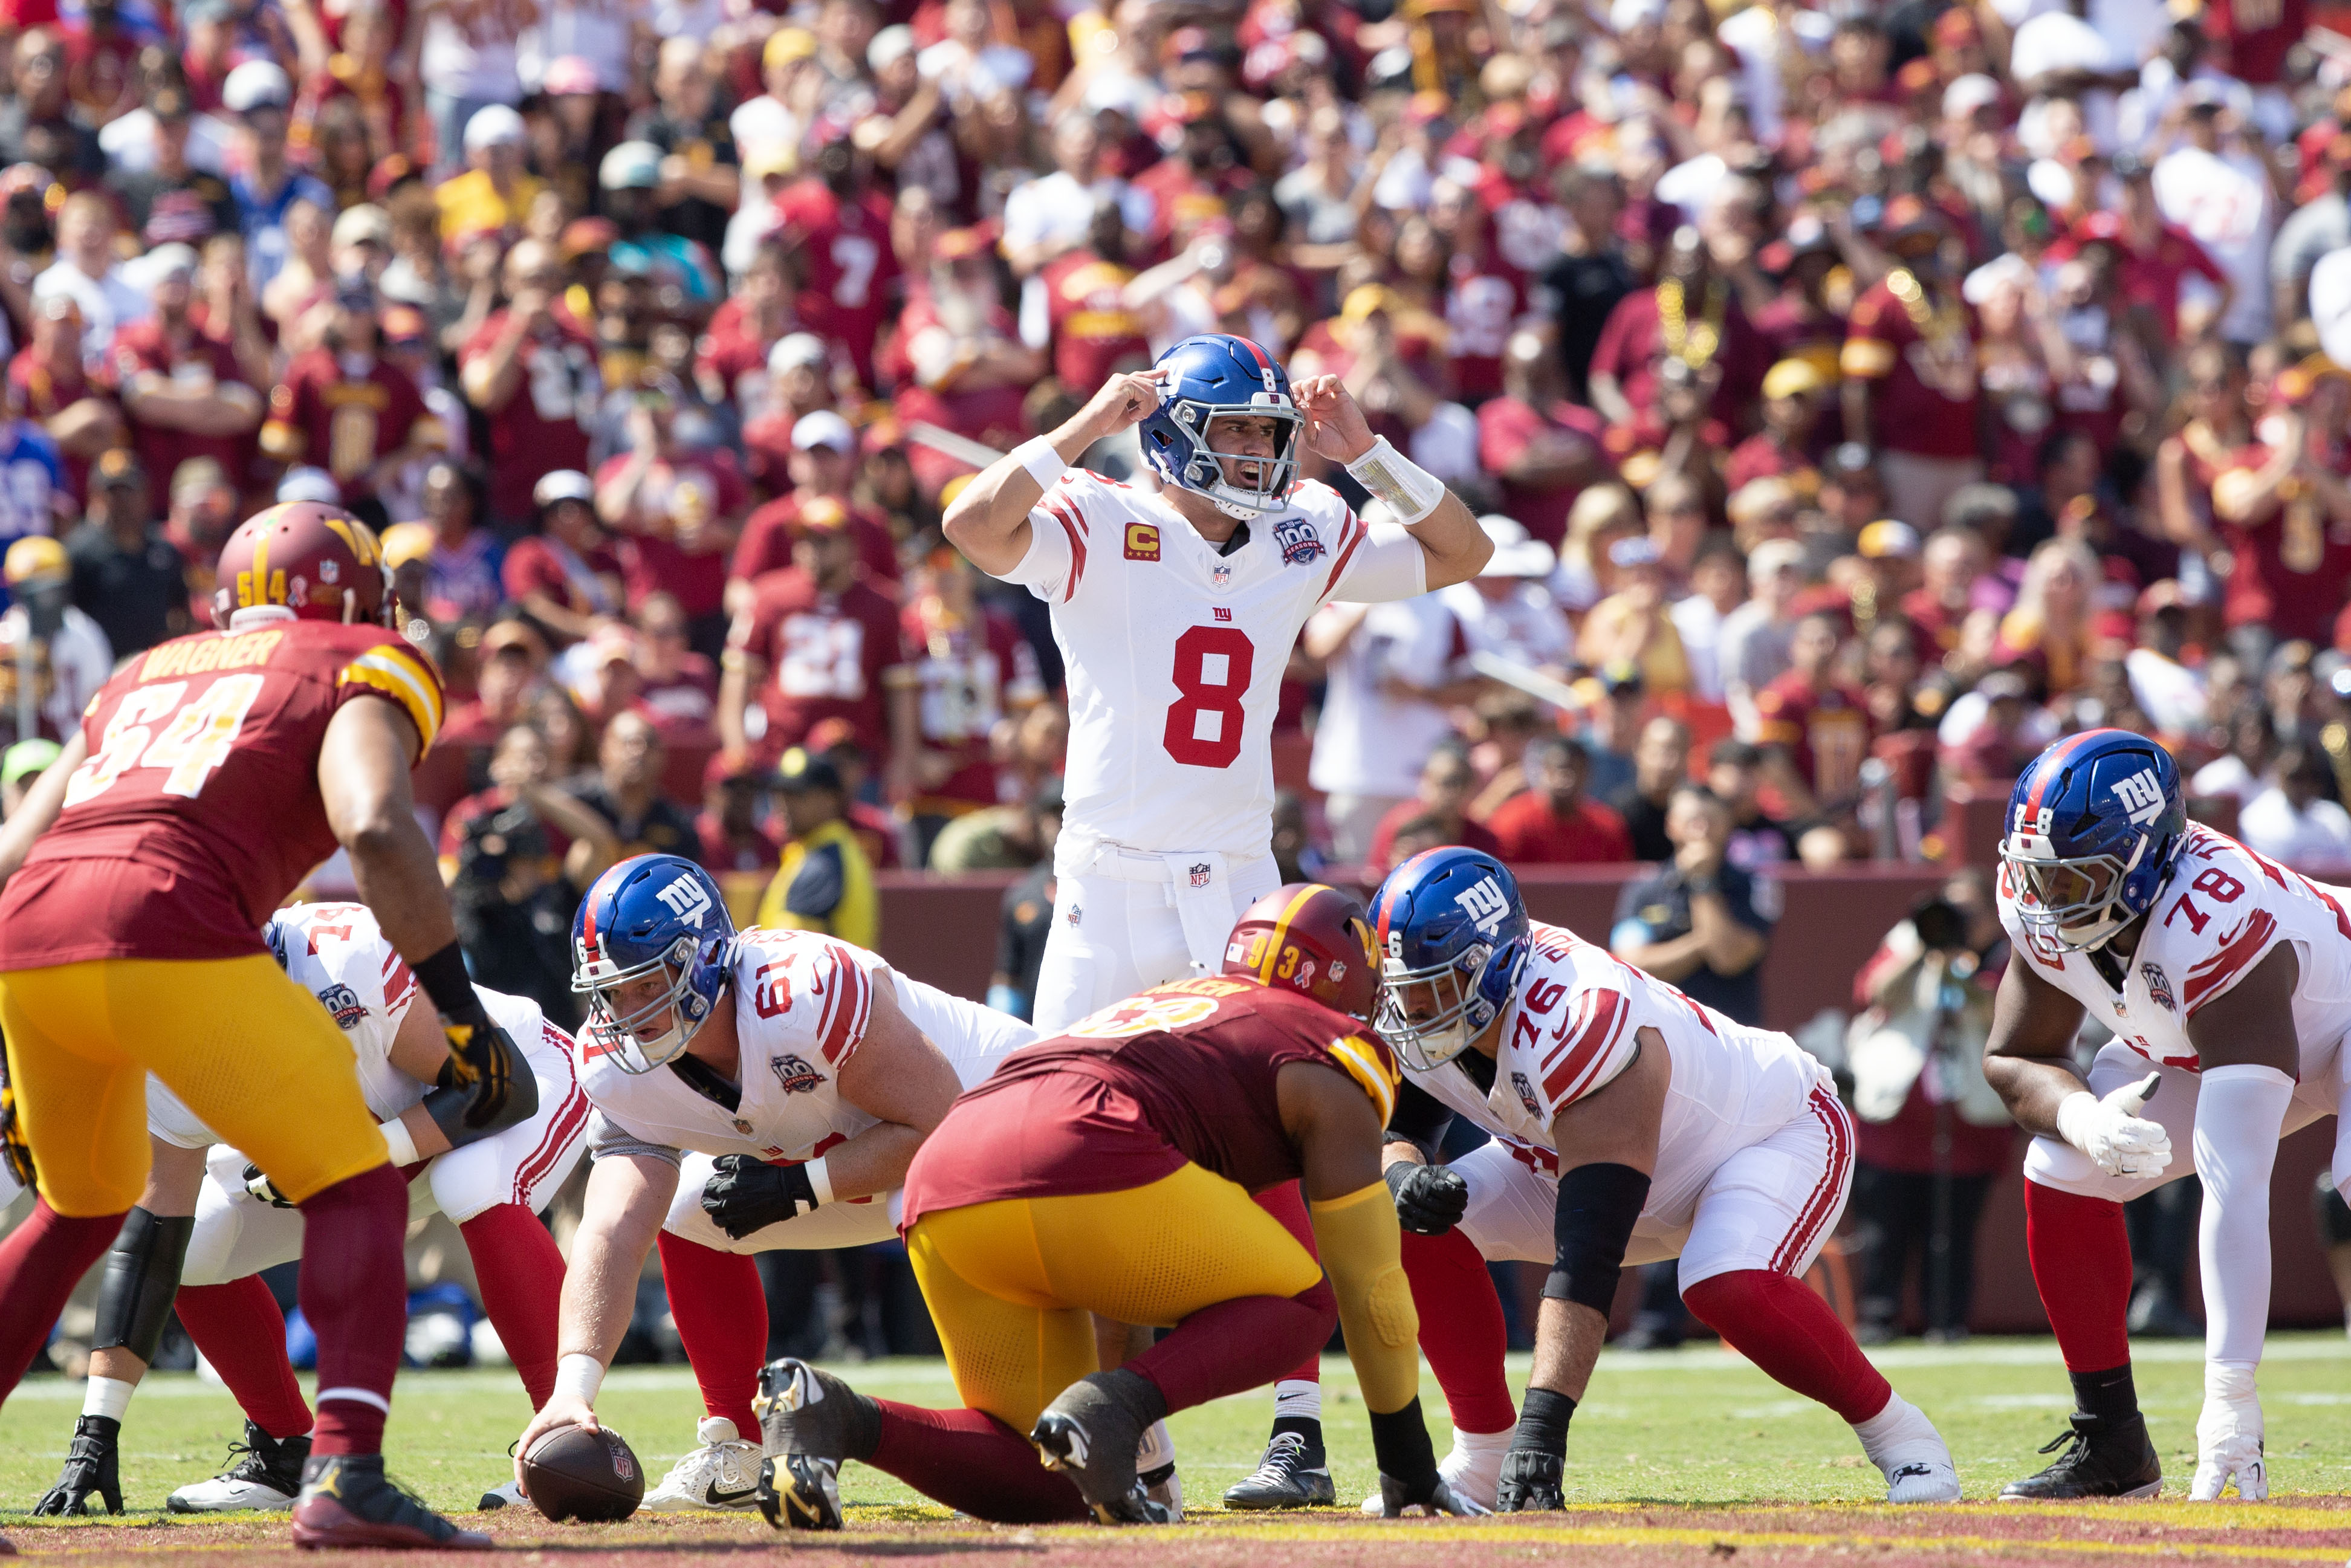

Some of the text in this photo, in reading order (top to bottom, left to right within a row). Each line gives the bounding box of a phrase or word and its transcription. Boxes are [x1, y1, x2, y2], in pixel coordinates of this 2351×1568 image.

[1262, 368, 1277, 392] 8
[1128, 525, 1158, 551] C
[1275, 523, 1318, 551] 100
[1286, 542, 1318, 555] SEASONS
[236, 568, 288, 608] 54
[1214, 574, 1228, 583] NFL
[139, 630, 284, 683] WAGNER
[1163, 625, 1254, 769] 8
[62, 673, 265, 812] 54
[2014, 803, 2054, 835] 78
[1190, 873, 1208, 886] NFL
[2164, 868, 2245, 936] 78
[576, 933, 608, 964] 61
[1247, 935, 1300, 980] 93
[755, 953, 798, 1020] 61
[325, 990, 357, 1016] 00
[335, 1008, 358, 1019] ASONS
[1512, 977, 1567, 1050] 76
[773, 1061, 812, 1082] 100
[615, 1457, 633, 1477] NFL
